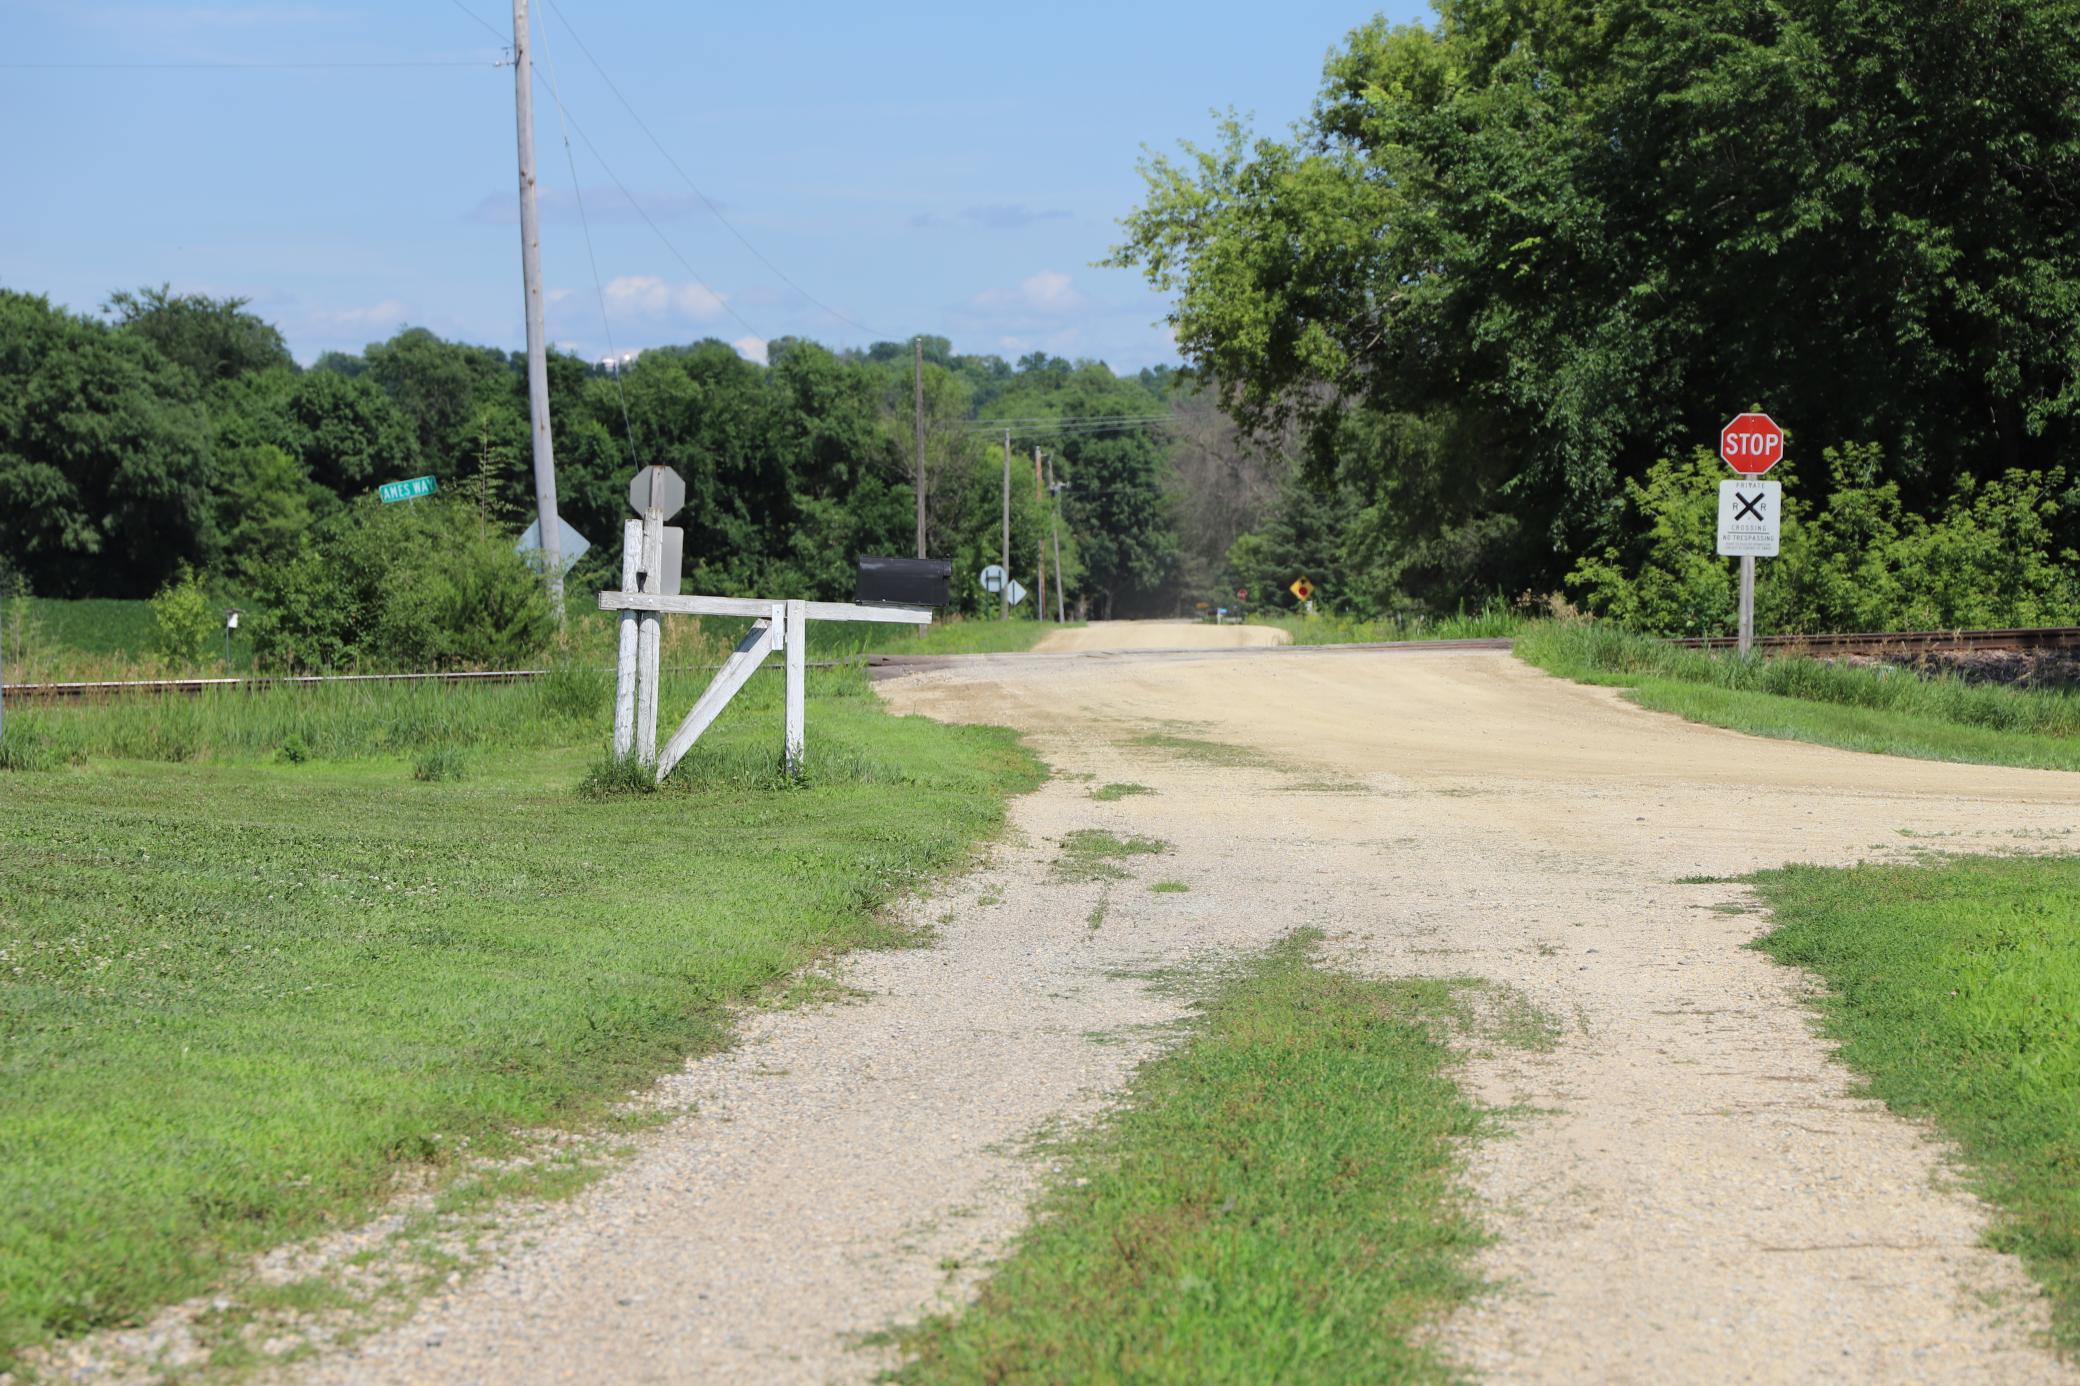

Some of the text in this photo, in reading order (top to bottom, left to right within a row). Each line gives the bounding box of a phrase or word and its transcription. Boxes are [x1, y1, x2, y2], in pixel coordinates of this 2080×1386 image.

[1725, 433, 1779, 456] STOP
[383, 478, 434, 500] AMES WAY
[1732, 502, 1739, 511] R
[1760, 503, 1767, 512] R
